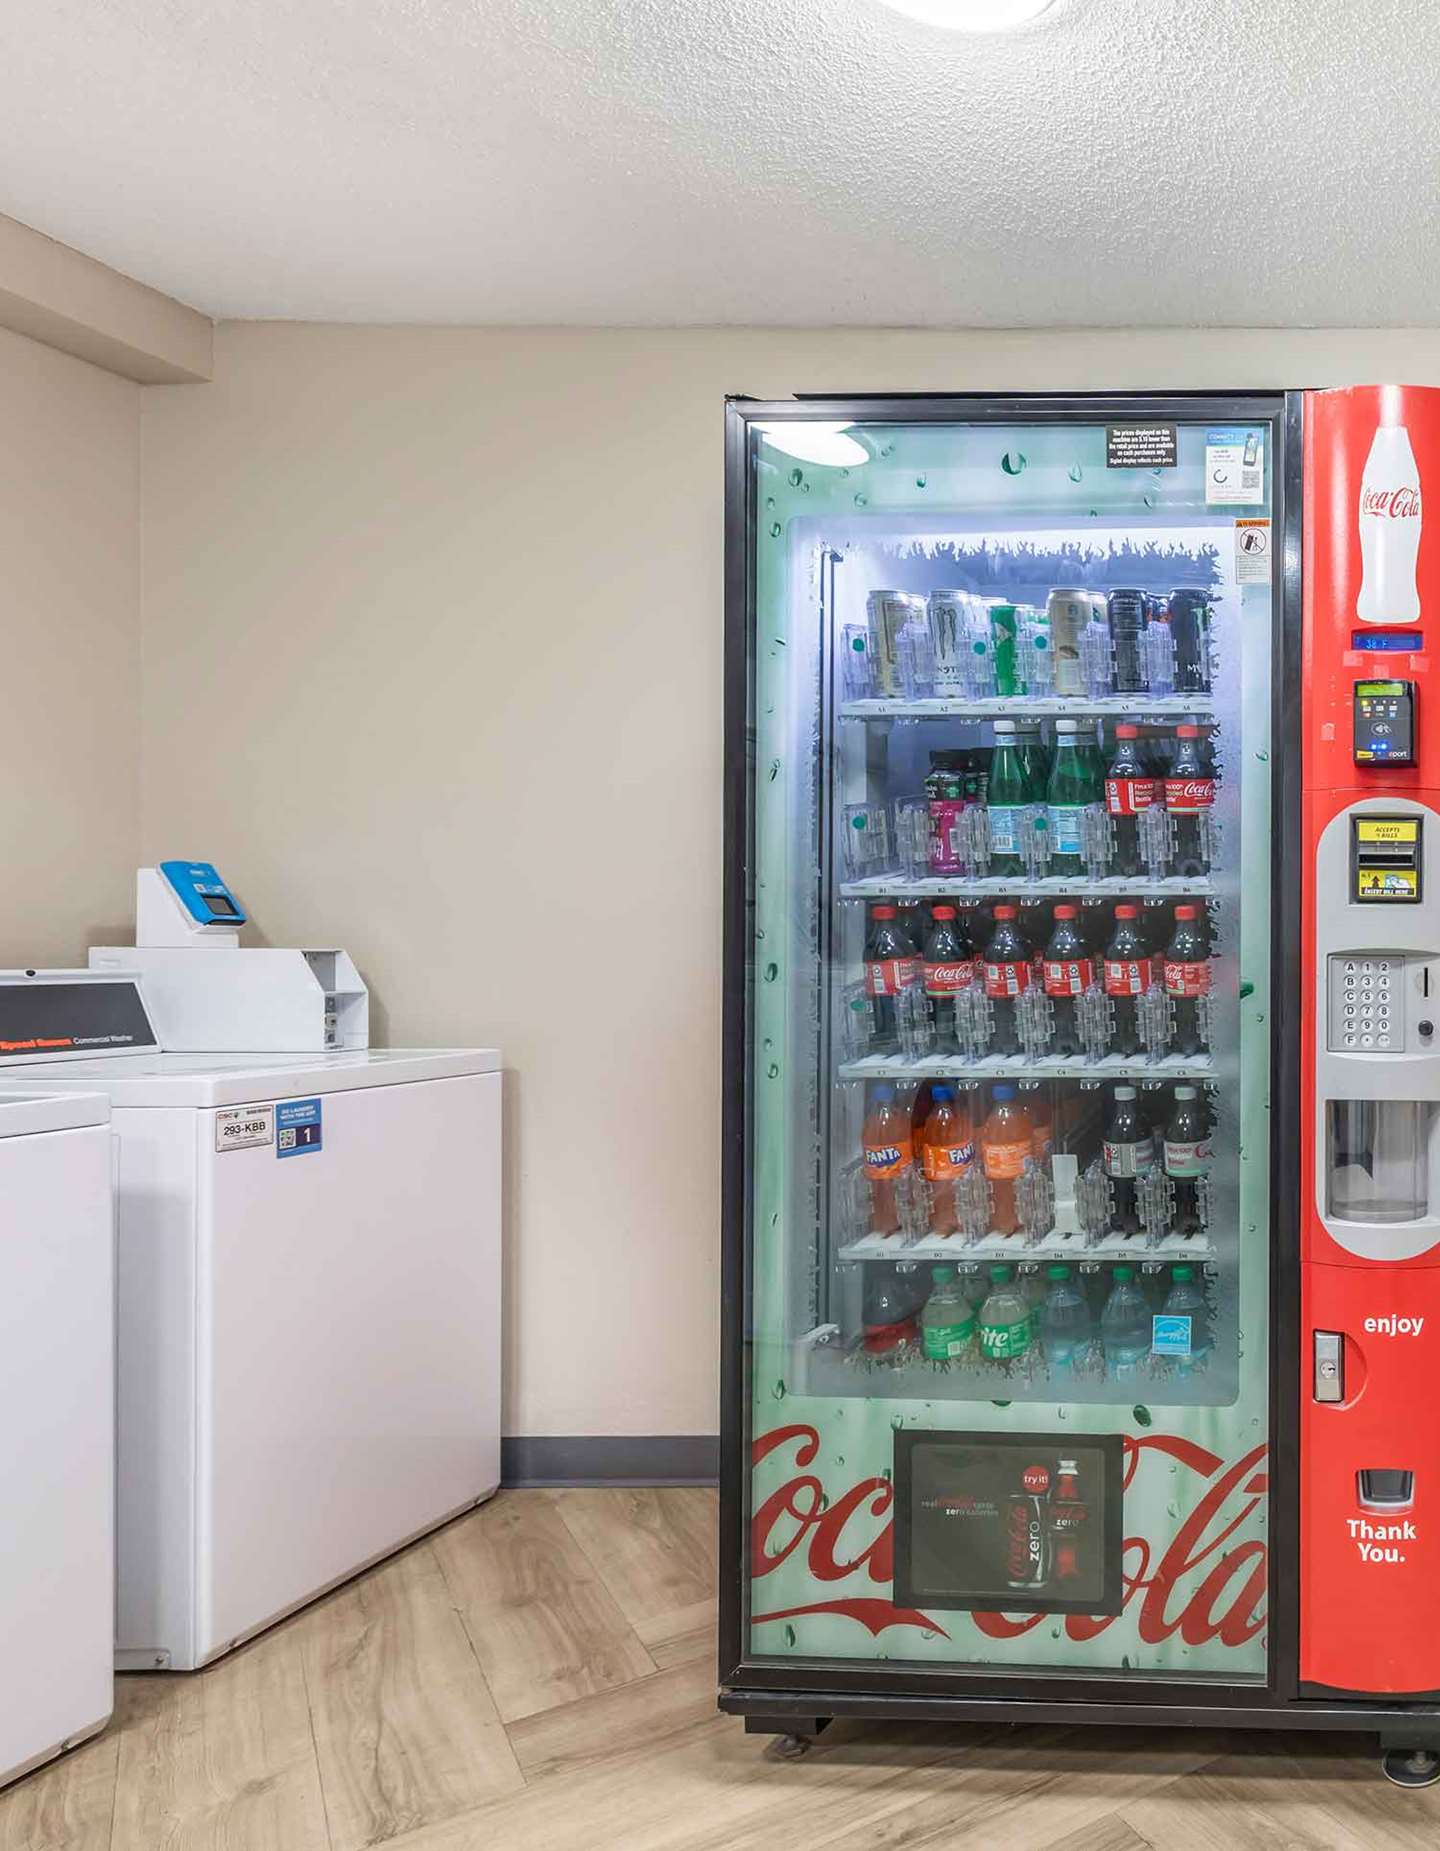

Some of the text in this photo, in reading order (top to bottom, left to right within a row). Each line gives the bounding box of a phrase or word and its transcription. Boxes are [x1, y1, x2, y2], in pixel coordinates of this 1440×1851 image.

[224, 1122, 266, 1136] 293-KBB
[304, 1128, 310, 1142] 1
[866, 1148, 901, 1163] FANTA
[1364, 1314, 1424, 1336] enjoy
[1024, 1475, 1038, 1485] try
[1347, 1520, 1416, 1540] Thank
[1029, 1521, 1040, 1562] zero
[1358, 1542, 1405, 1562] You.
